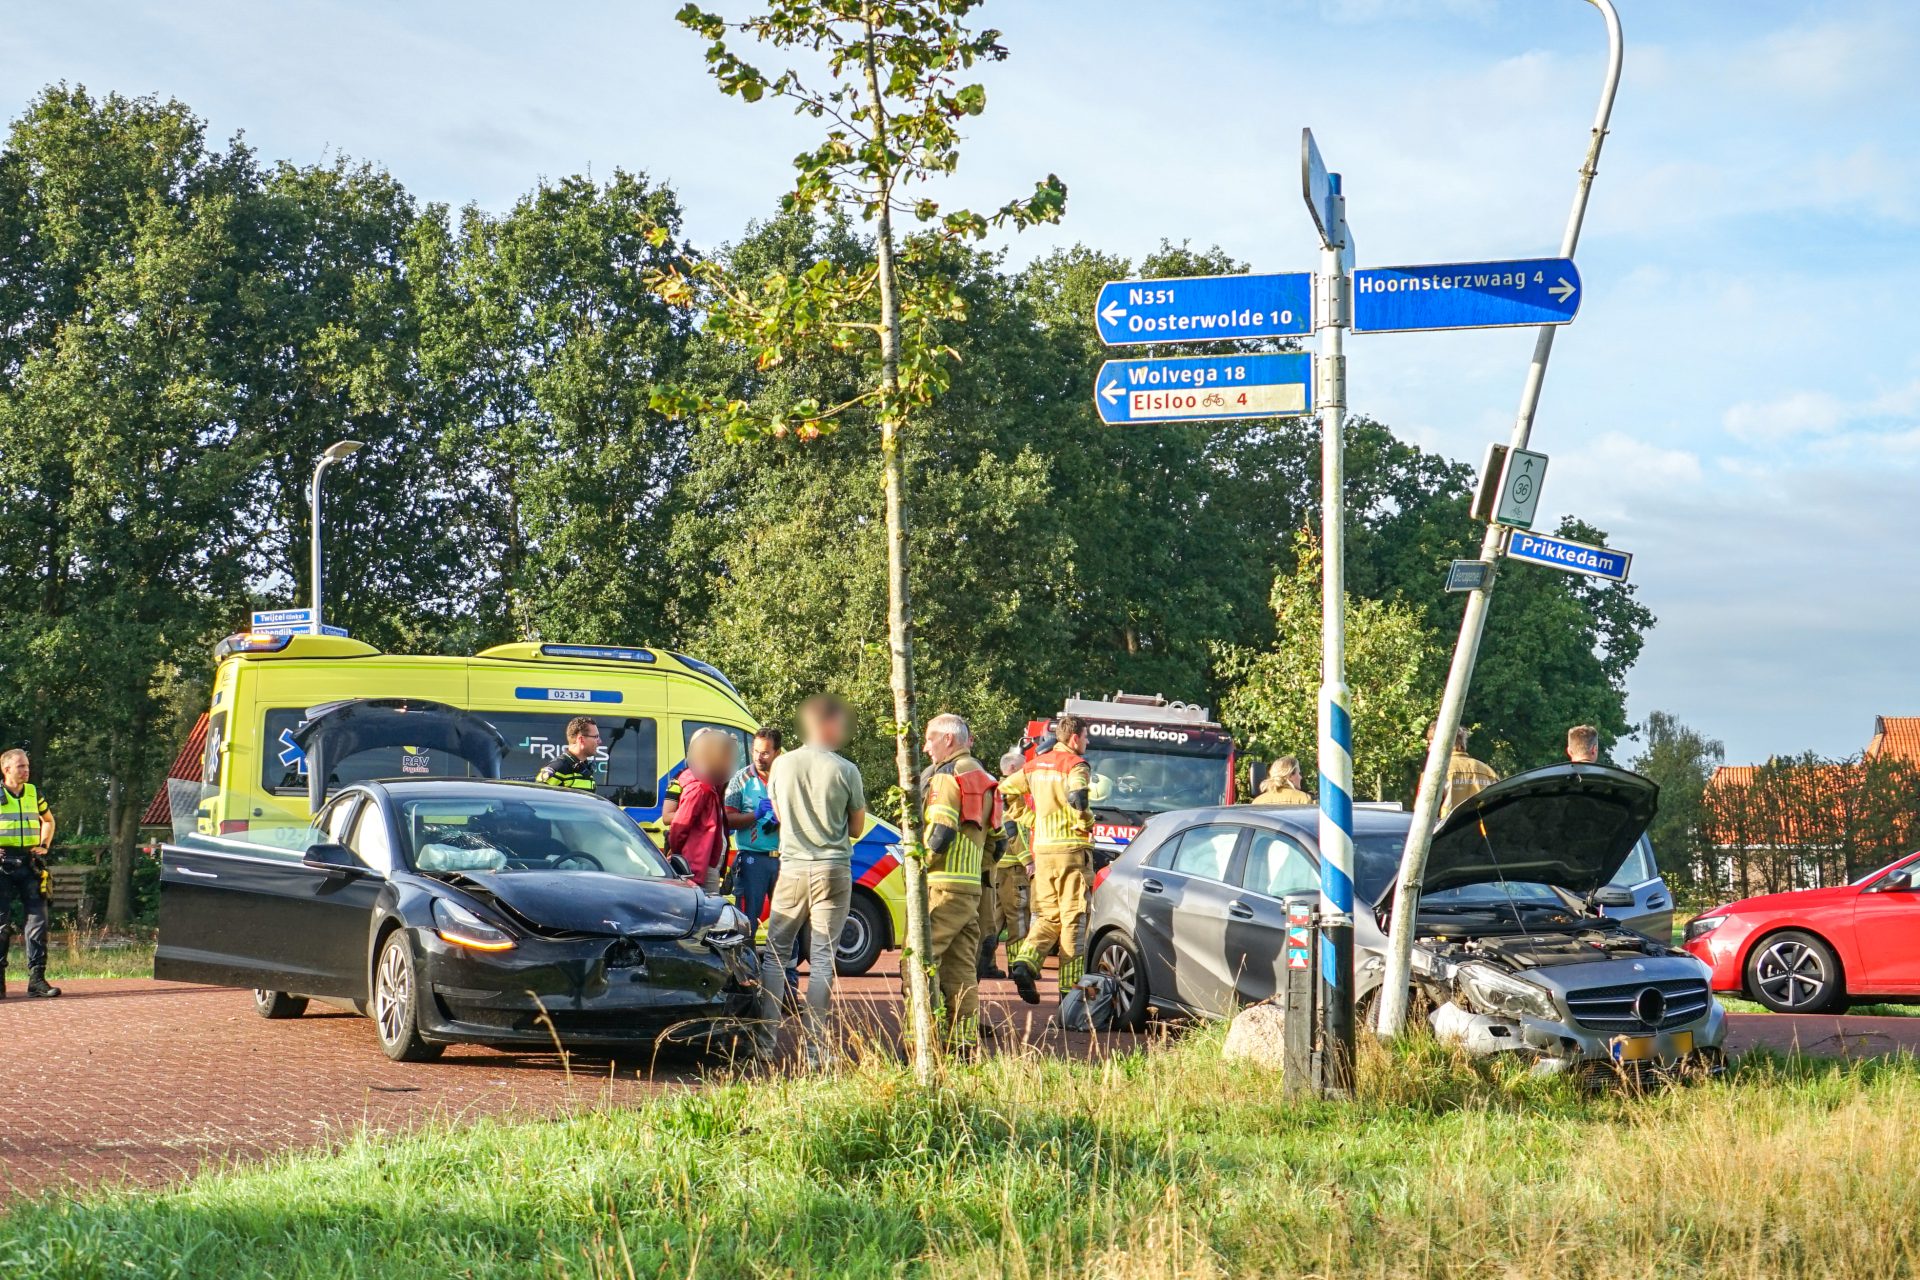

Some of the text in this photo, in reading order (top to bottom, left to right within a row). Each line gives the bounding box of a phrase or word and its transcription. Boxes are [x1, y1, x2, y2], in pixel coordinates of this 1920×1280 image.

[1359, 270, 1544, 294] Hoornsterzwaag 4
[1129, 289, 1174, 306] N351
[1129, 309, 1292, 332] Oosterwolde 10
[1129, 366, 1246, 386] Wolvega 18
[1134, 393, 1248, 411] Elsloo 4
[1515, 483, 1529, 496] 36
[1521, 537, 1613, 571] Prikkedam
[554, 690, 585, 699] 02-134
[1089, 724, 1188, 744] Oldeberkoop
[402, 755, 430, 767] RAV
[1093, 825, 1139, 839] RAND
